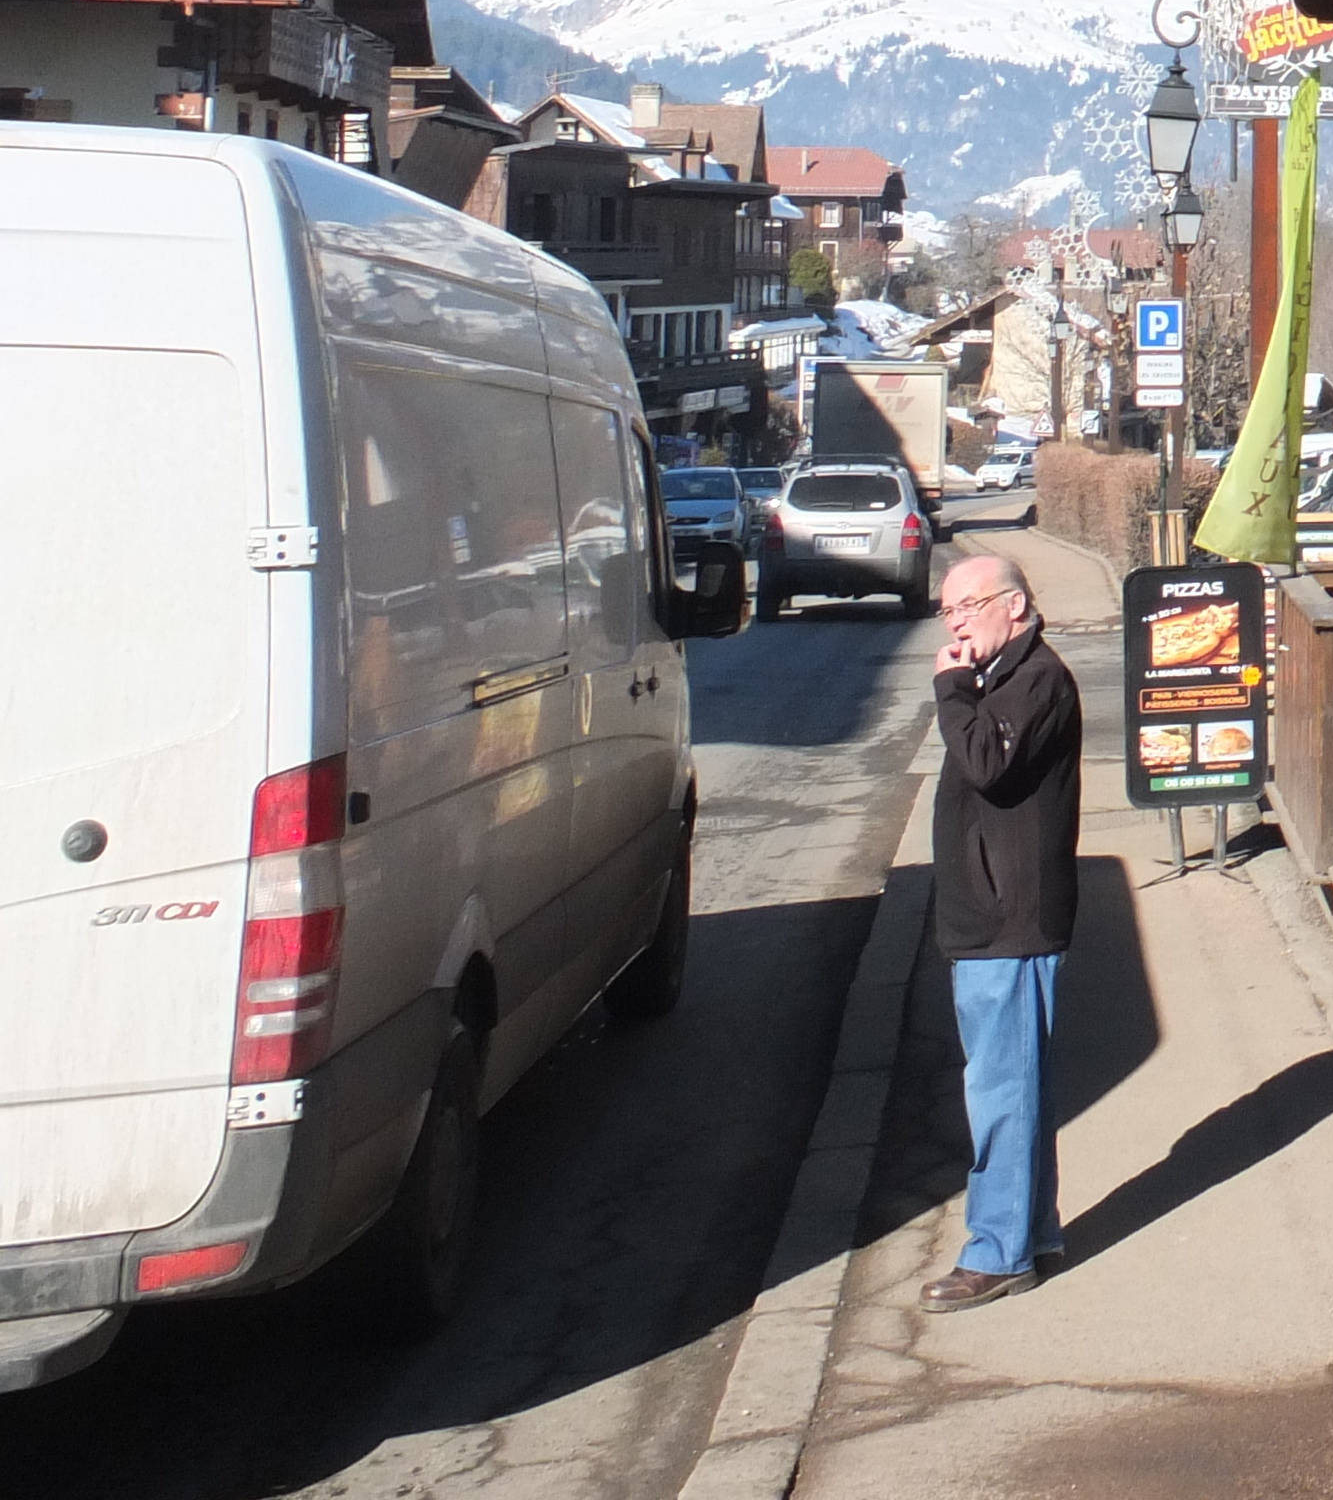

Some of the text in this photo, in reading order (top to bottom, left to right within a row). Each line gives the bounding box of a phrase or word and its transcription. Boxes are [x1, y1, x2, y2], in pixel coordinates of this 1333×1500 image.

[1148, 310, 1170, 341] P
[1161, 580, 1224, 598] PIZZAS
[155, 900, 220, 921] CDI
